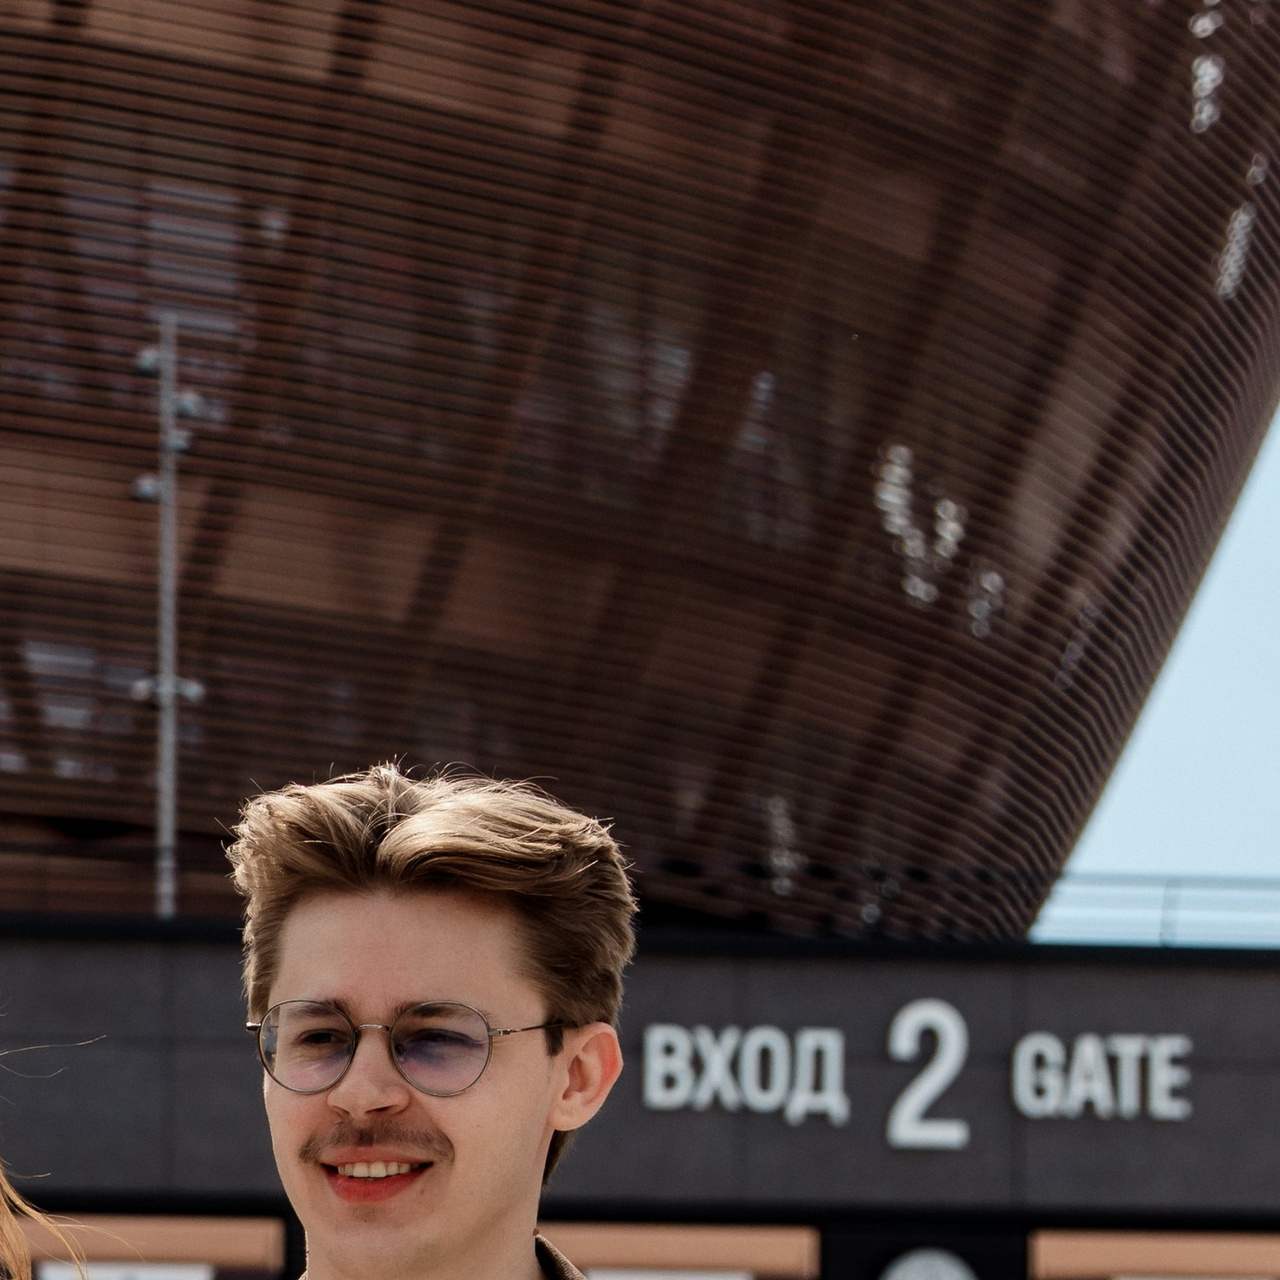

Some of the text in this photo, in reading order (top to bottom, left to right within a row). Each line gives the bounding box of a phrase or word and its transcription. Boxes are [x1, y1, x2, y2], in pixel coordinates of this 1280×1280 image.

[643, 998, 1193, 1149] ВХОД 2 GATE
